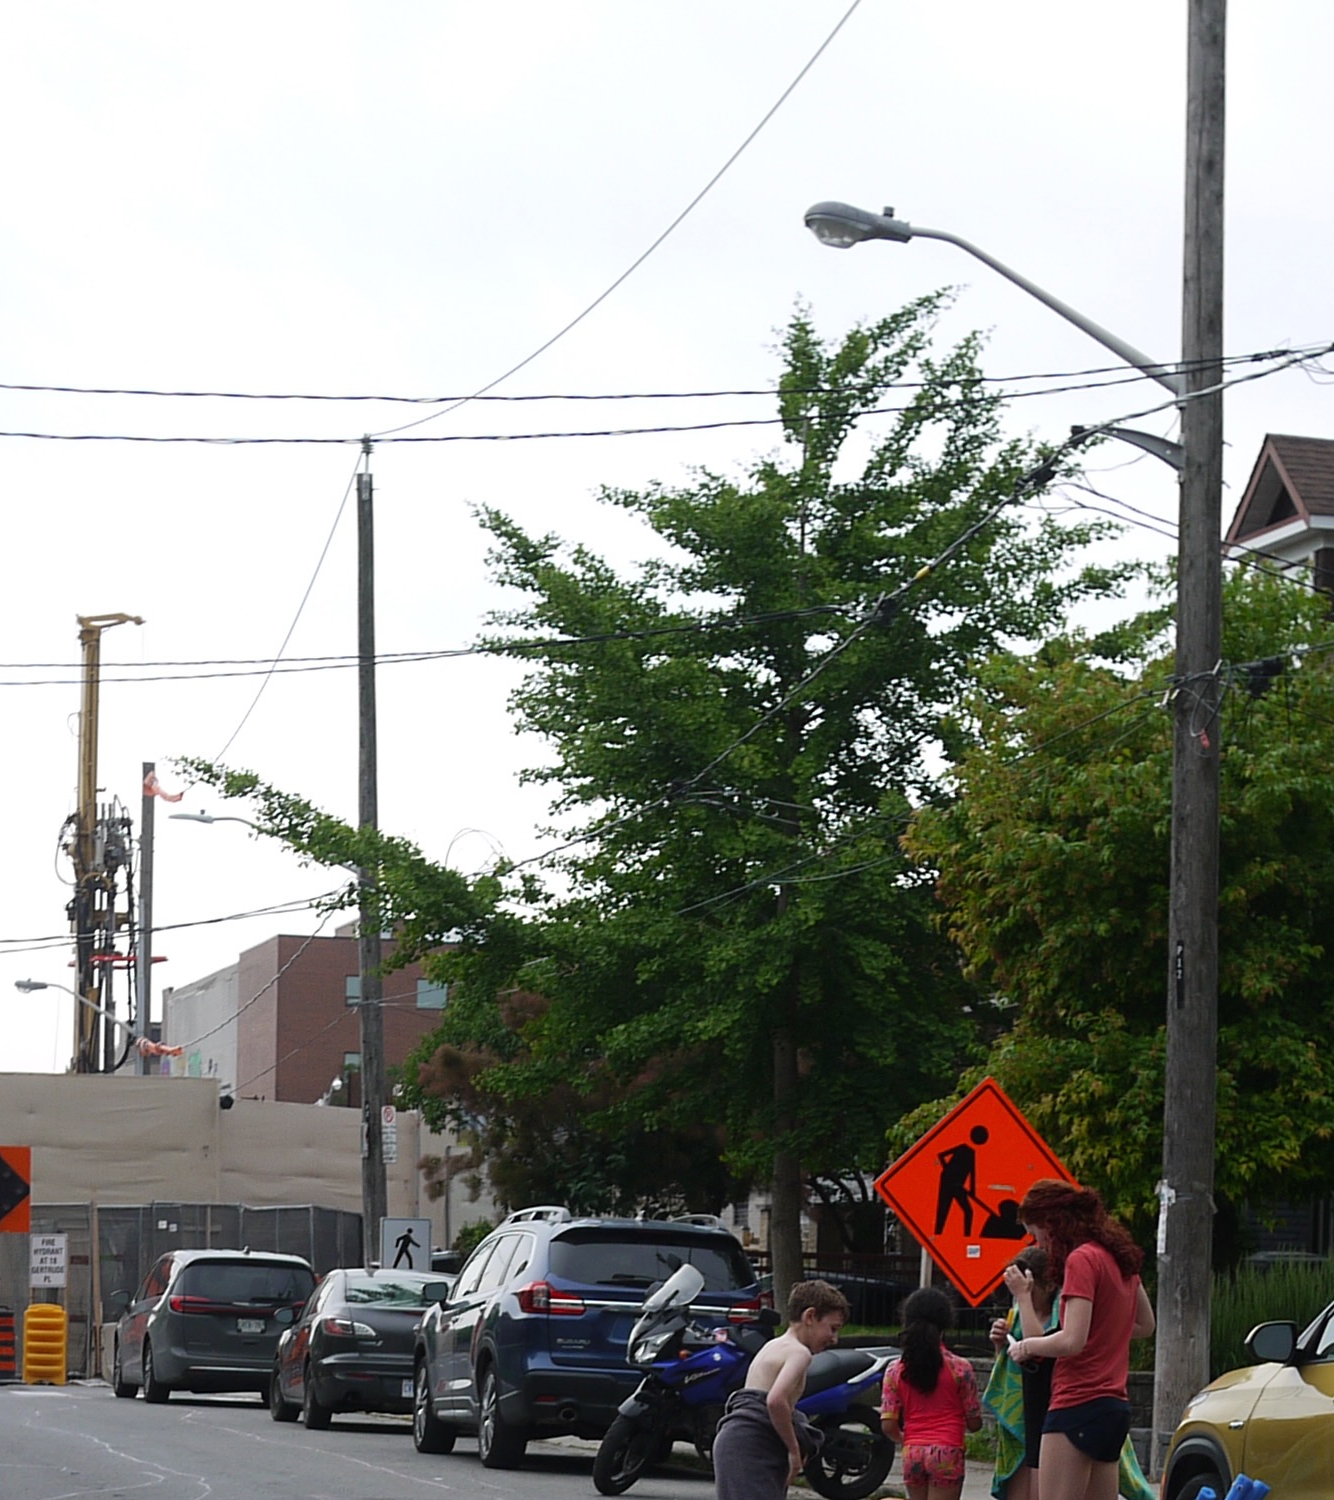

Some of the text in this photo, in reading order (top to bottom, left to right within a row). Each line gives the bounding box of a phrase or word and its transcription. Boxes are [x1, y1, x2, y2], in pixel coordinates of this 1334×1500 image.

[41, 1238, 55, 1246] FIRE
[33, 1247, 64, 1255] HYDRANT
[39, 1256, 48, 1264] AT
[31, 1265, 64, 1274] GERTRUDE
[43, 1275, 52, 1283] PL
